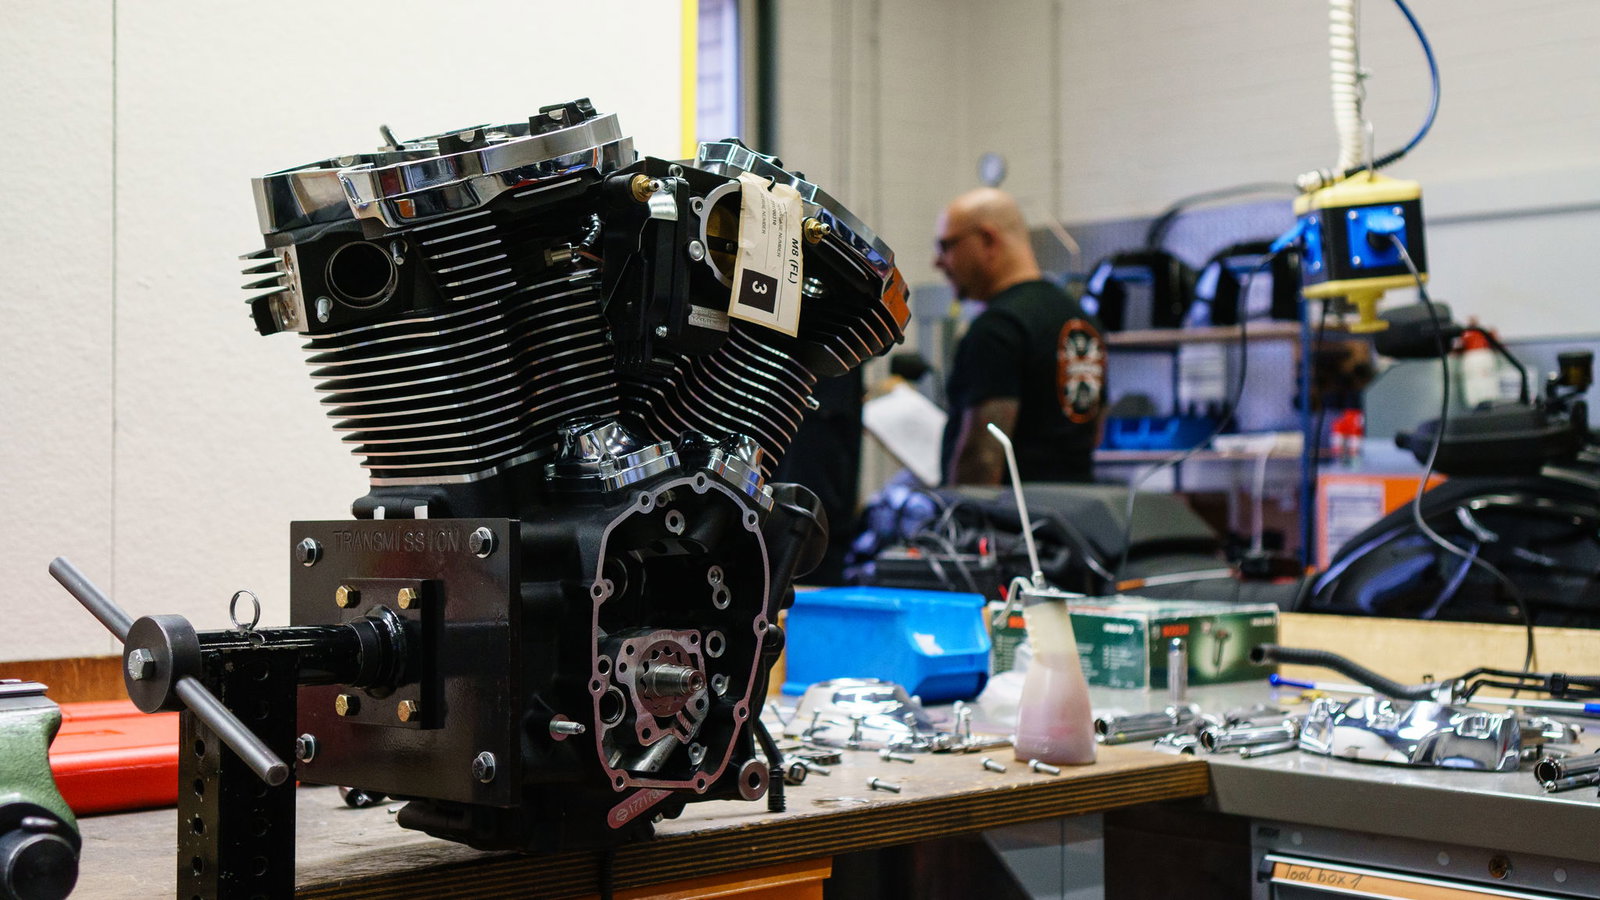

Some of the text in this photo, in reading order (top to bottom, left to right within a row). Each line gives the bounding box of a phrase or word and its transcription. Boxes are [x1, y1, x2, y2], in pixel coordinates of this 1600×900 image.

[788, 238, 799, 284] M8 (FL)
[752, 280, 768, 295] 3
[333, 530, 460, 553] TRANSMISSION
[1317, 869, 1346, 885] box
[1351, 875, 1364, 889] 1
